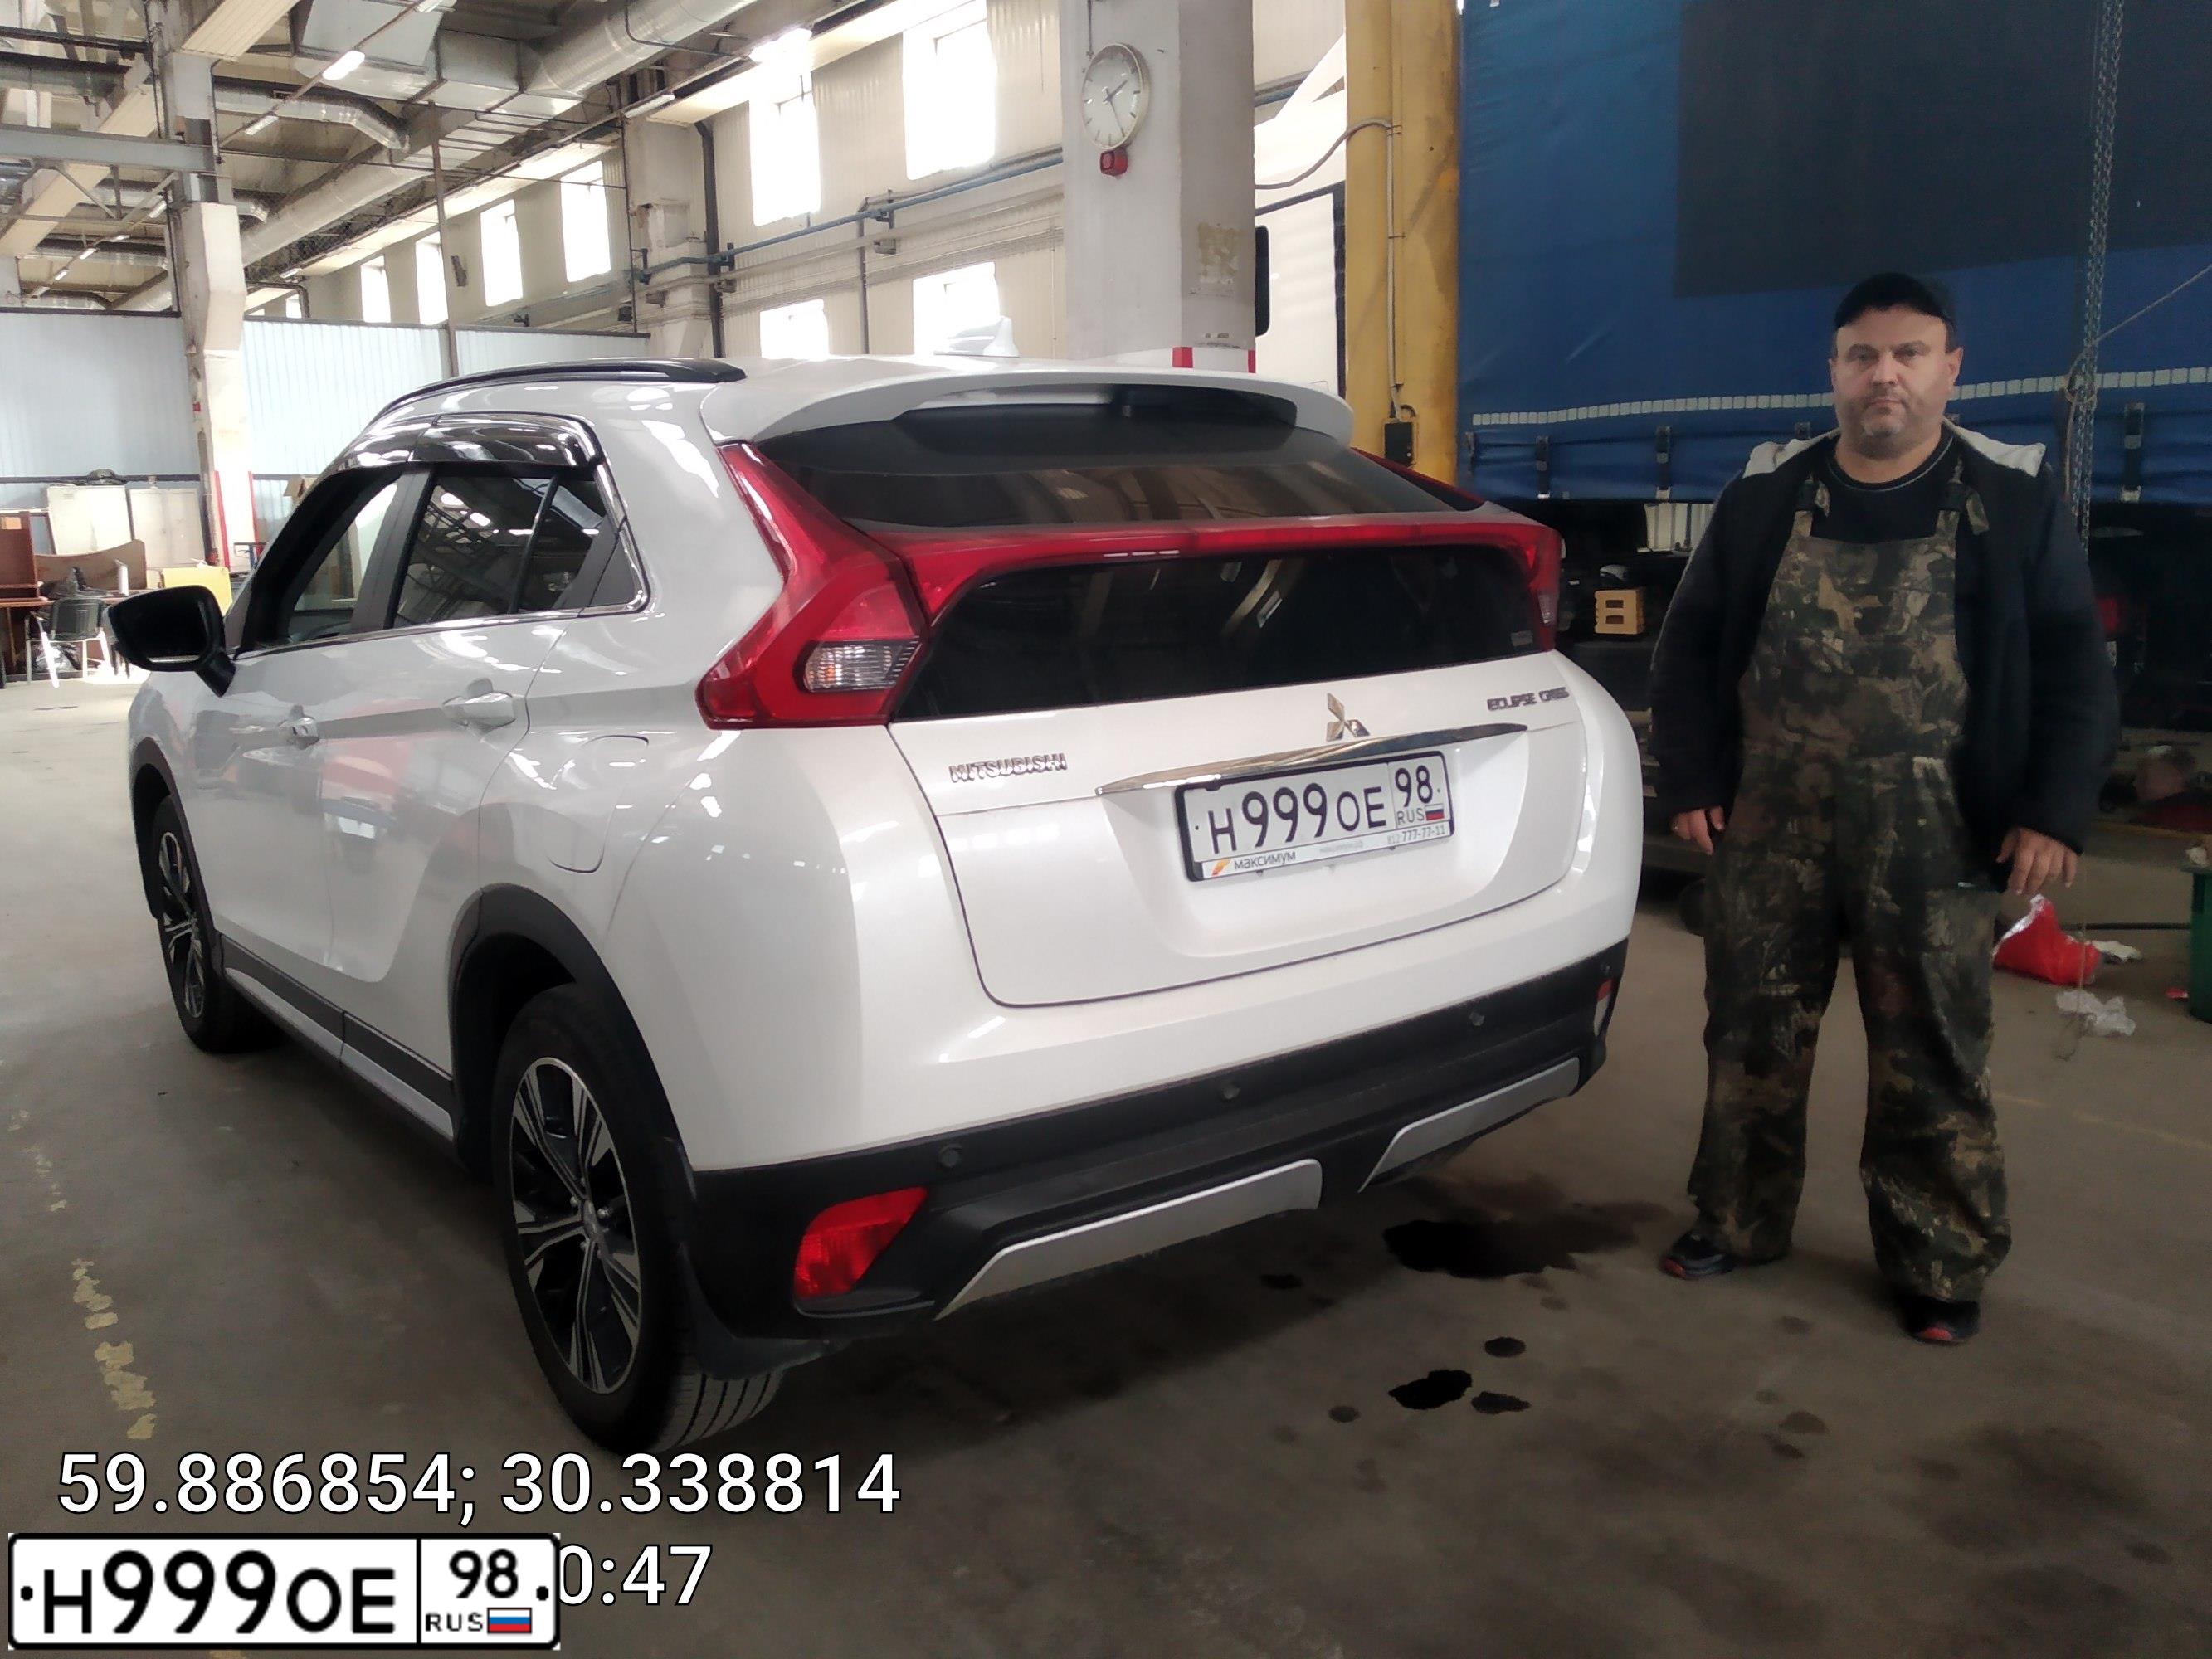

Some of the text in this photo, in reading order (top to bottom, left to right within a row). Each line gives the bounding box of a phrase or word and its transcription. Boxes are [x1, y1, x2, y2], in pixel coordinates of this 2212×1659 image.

[948, 752, 1068, 783] MITSUBISHI
[1394, 765, 1433, 807] 98
[1397, 807, 1425, 825] RUS
[1402, 825, 1445, 842] 777-77-11
